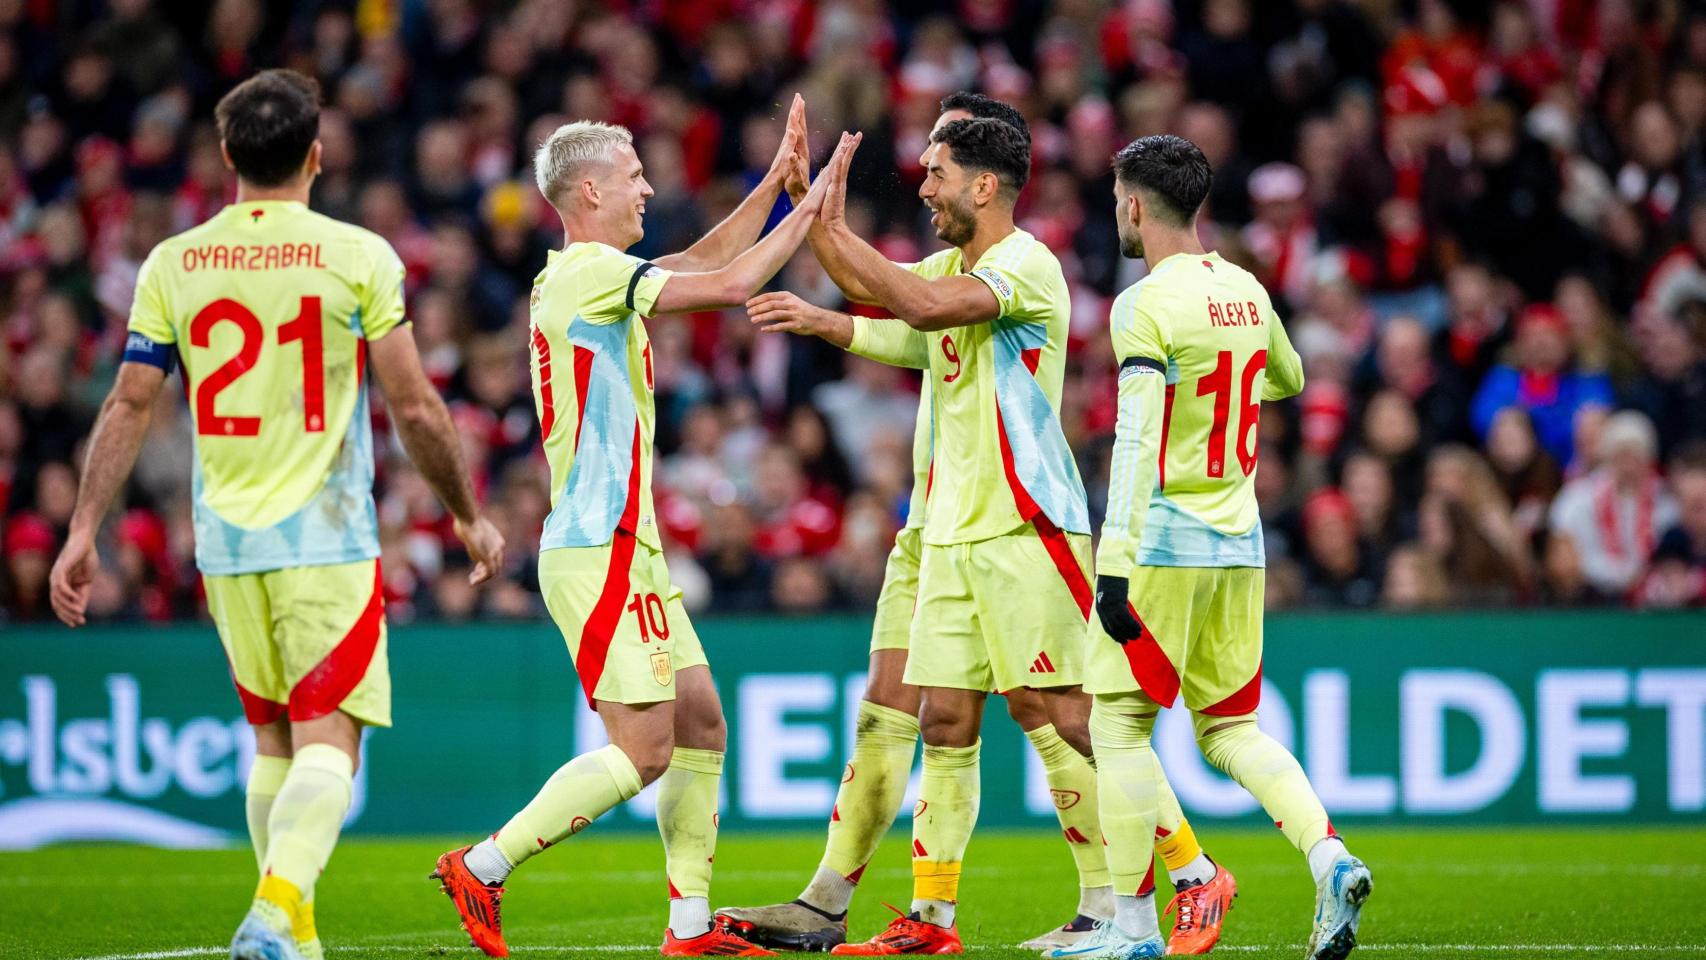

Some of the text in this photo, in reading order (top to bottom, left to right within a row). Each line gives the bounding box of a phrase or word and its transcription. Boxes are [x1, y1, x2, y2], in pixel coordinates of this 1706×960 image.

[183, 242, 327, 273] OYARZABAL
[1207, 296, 1264, 328] ÁLEX B.
[189, 295, 326, 437] 21
[941, 334, 961, 383] 9
[1196, 349, 1268, 479] 16
[627, 592, 670, 643] 10
[1025, 668, 1706, 815] OLDET
